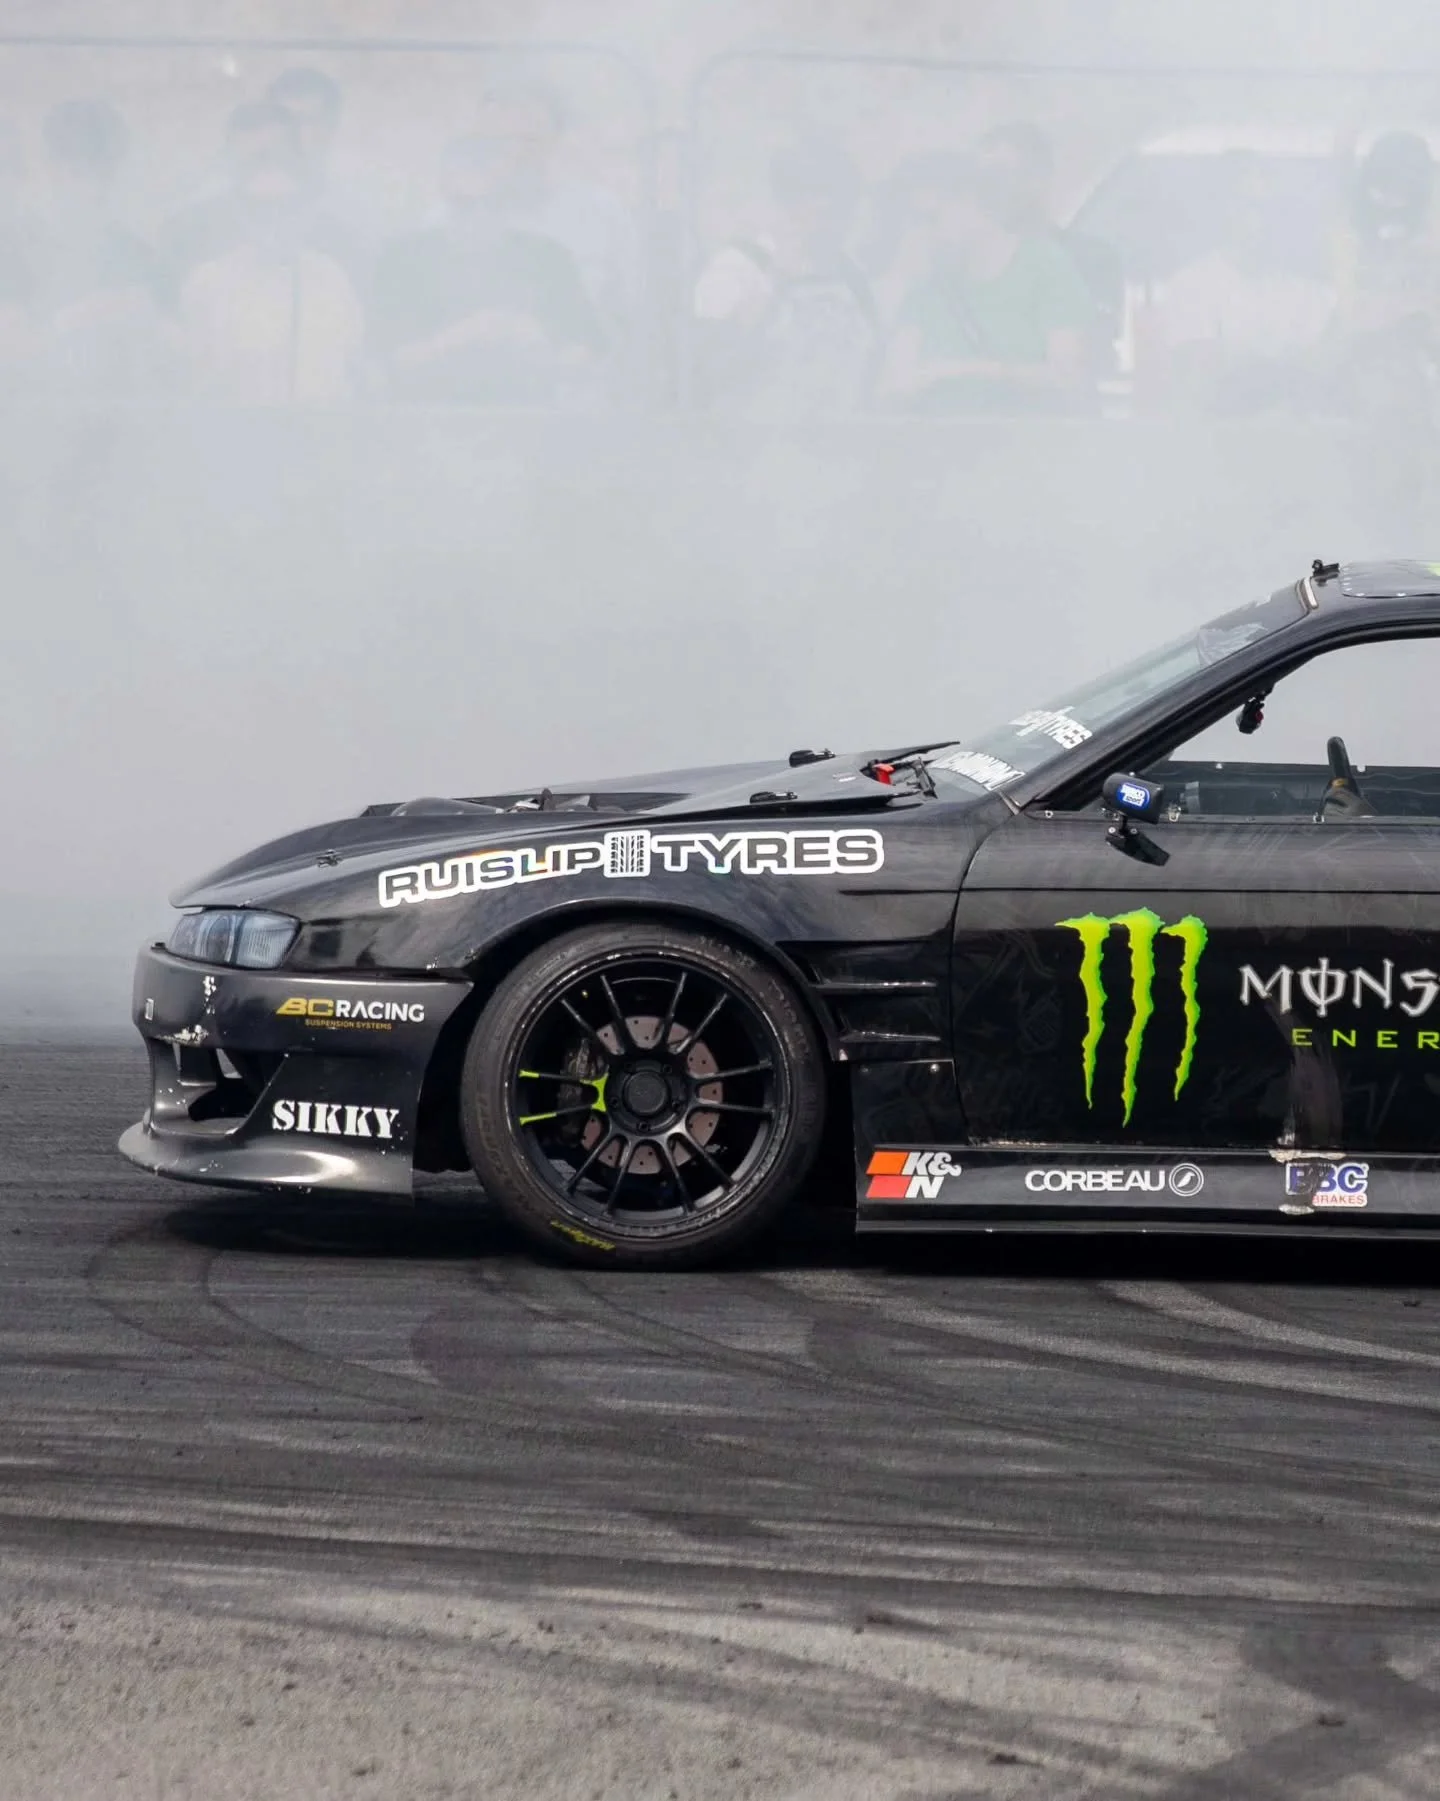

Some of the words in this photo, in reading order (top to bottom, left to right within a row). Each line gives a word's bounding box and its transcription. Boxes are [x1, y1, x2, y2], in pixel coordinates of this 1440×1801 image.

[378, 842, 605, 908] RUISLIP
[652, 829, 885, 874] TYRES
[276, 997, 334, 1017] BC
[336, 999, 425, 1023] RACING
[304, 1018, 354, 1029] SUSPENSION
[355, 1021, 392, 1031] SYSTEMS
[1292, 1027, 1440, 1049] ENER
[272, 1099, 399, 1138] SIKKY
[1025, 1169, 1166, 1191] CORBEAU
